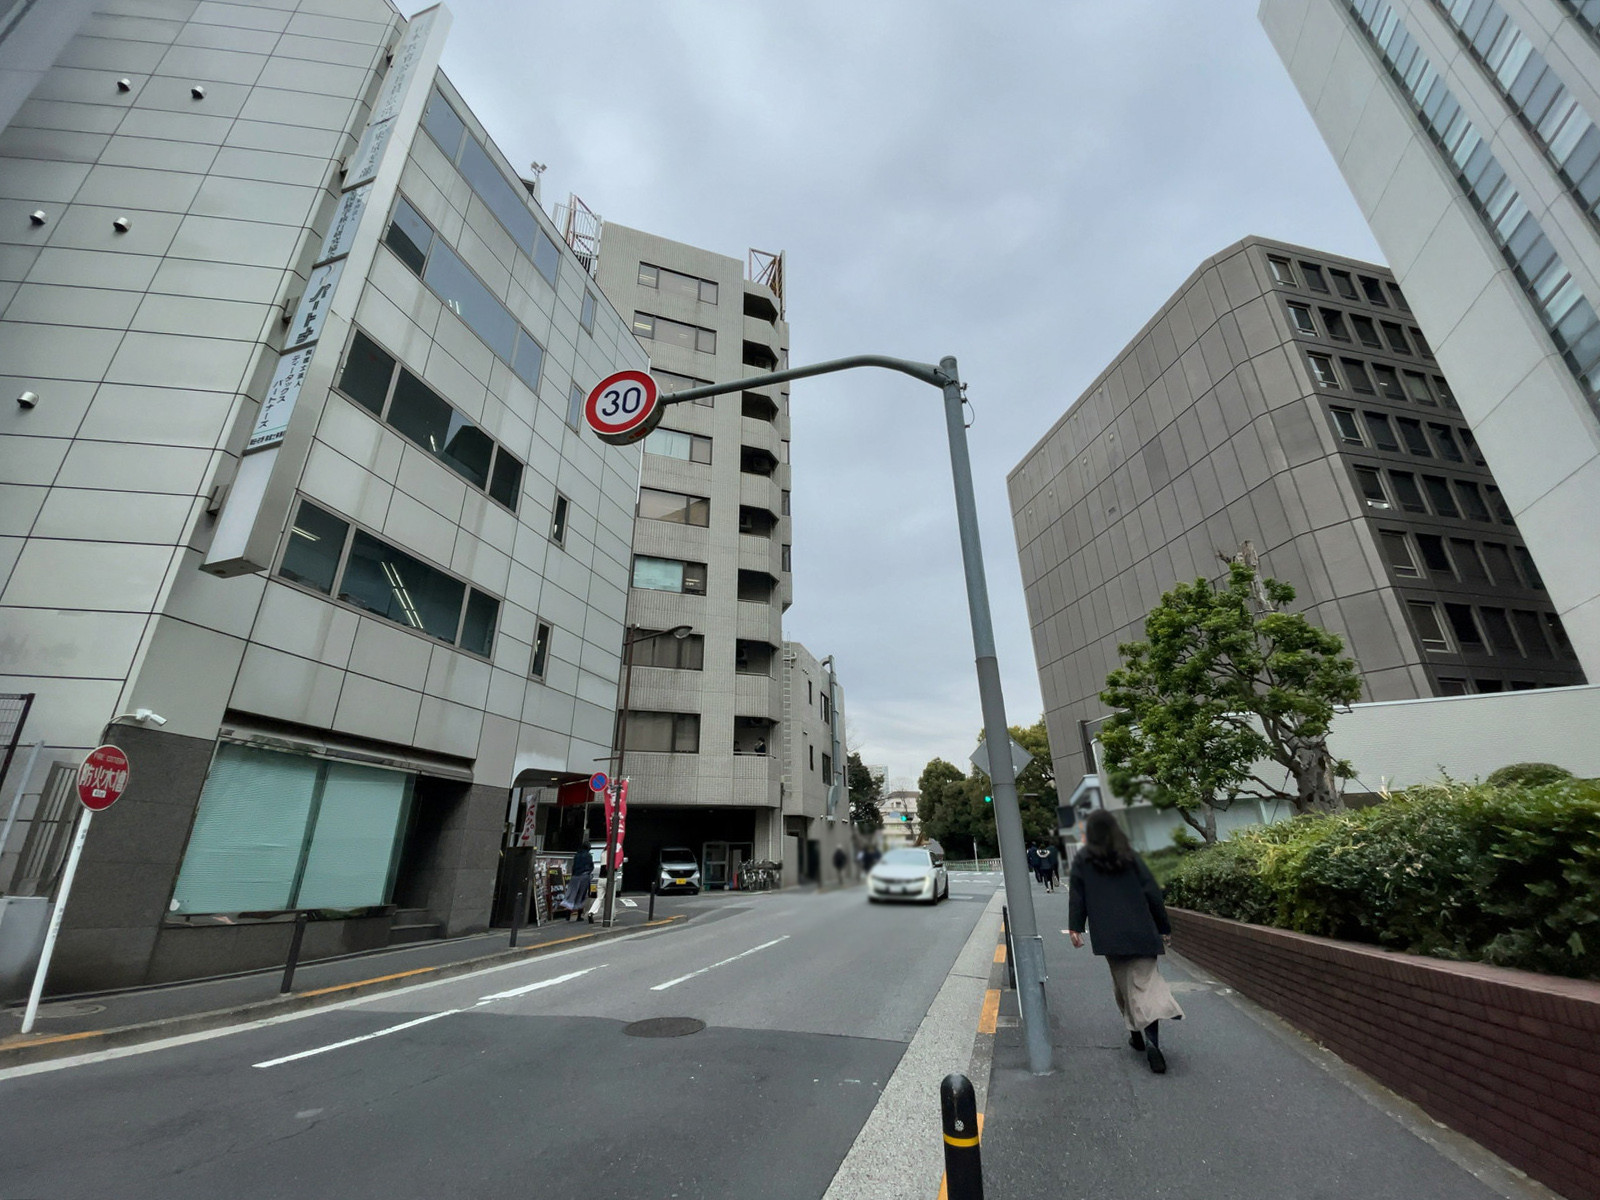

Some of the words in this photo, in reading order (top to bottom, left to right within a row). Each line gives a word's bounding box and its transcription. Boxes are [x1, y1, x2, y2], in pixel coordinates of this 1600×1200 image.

[602, 387, 641, 417] 30
[79, 763, 127, 792] 防火水槽
